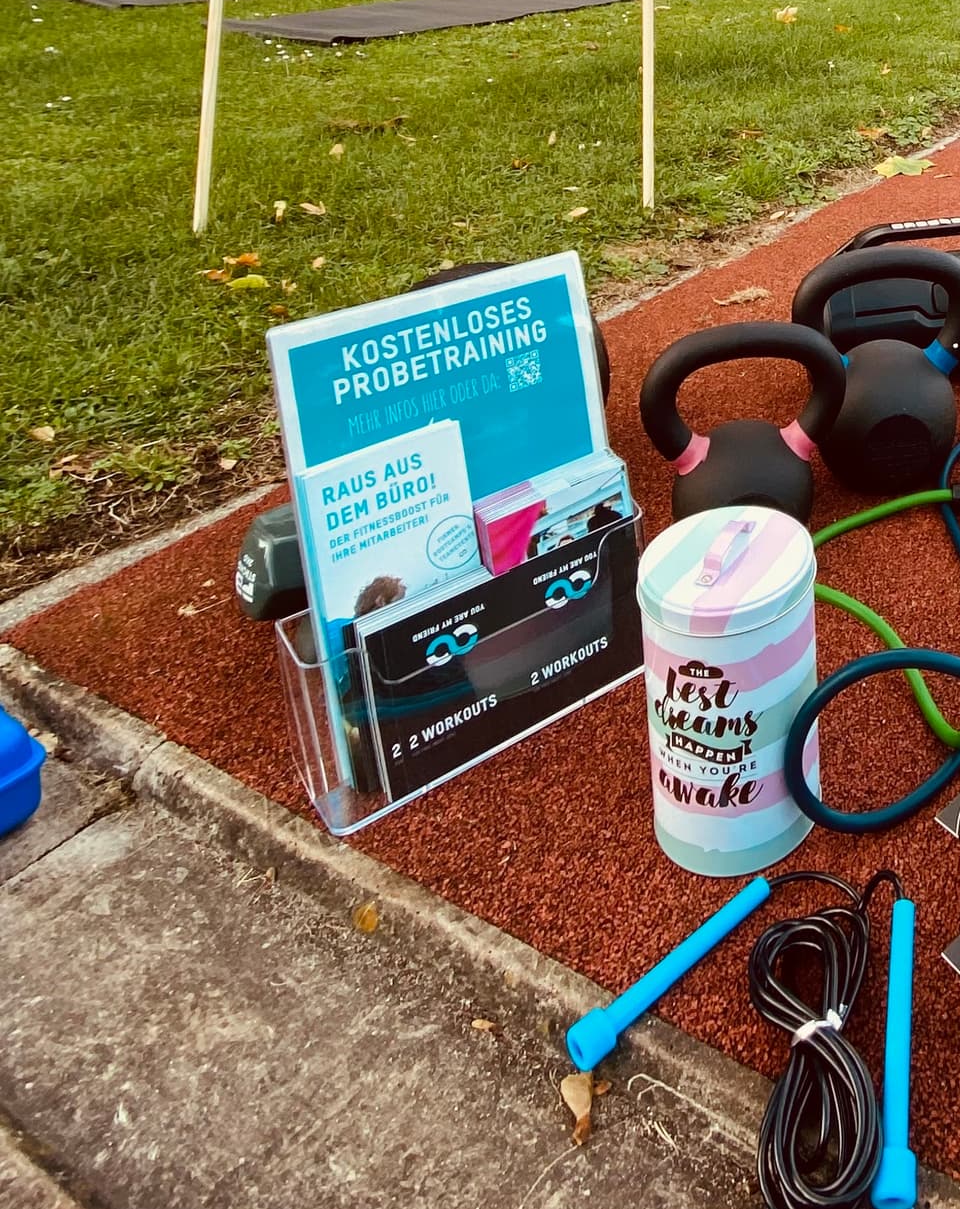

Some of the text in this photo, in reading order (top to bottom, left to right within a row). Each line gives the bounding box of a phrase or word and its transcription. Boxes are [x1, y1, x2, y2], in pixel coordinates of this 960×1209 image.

[341, 296, 532, 372] KOSTENLOSES
[332, 319, 548, 405] PROBETRAINING
[348, 372, 501, 437] MEHR INFOS HIER ODER DA:
[322, 453, 423, 506] RAUS AUS
[326, 473, 436, 531] DEM BÜRO!
[329, 492, 450, 549] DER FITNESSBOOST FÜR
[332, 514, 429, 563] IHRE MITARBEITER!
[532, 551, 598, 585] YOU ARE MY FRIEND
[412, 603, 486, 642] YOU ARE MY FRIEND
[530, 671, 540, 686] 2
[541, 636, 609, 680] WORKOUTS
[689, 667, 710, 678] THE
[666, 665, 739, 712] best
[409, 734, 419, 750] 2
[421, 694, 498, 743] WORKOUTS
[654, 695, 764, 738] dreams
[391, 743, 402, 759] 2
[659, 749, 758, 776] WHEN YOU'RE
[675, 735, 737, 763] HAPPEN
[659, 772, 764, 808] awake
